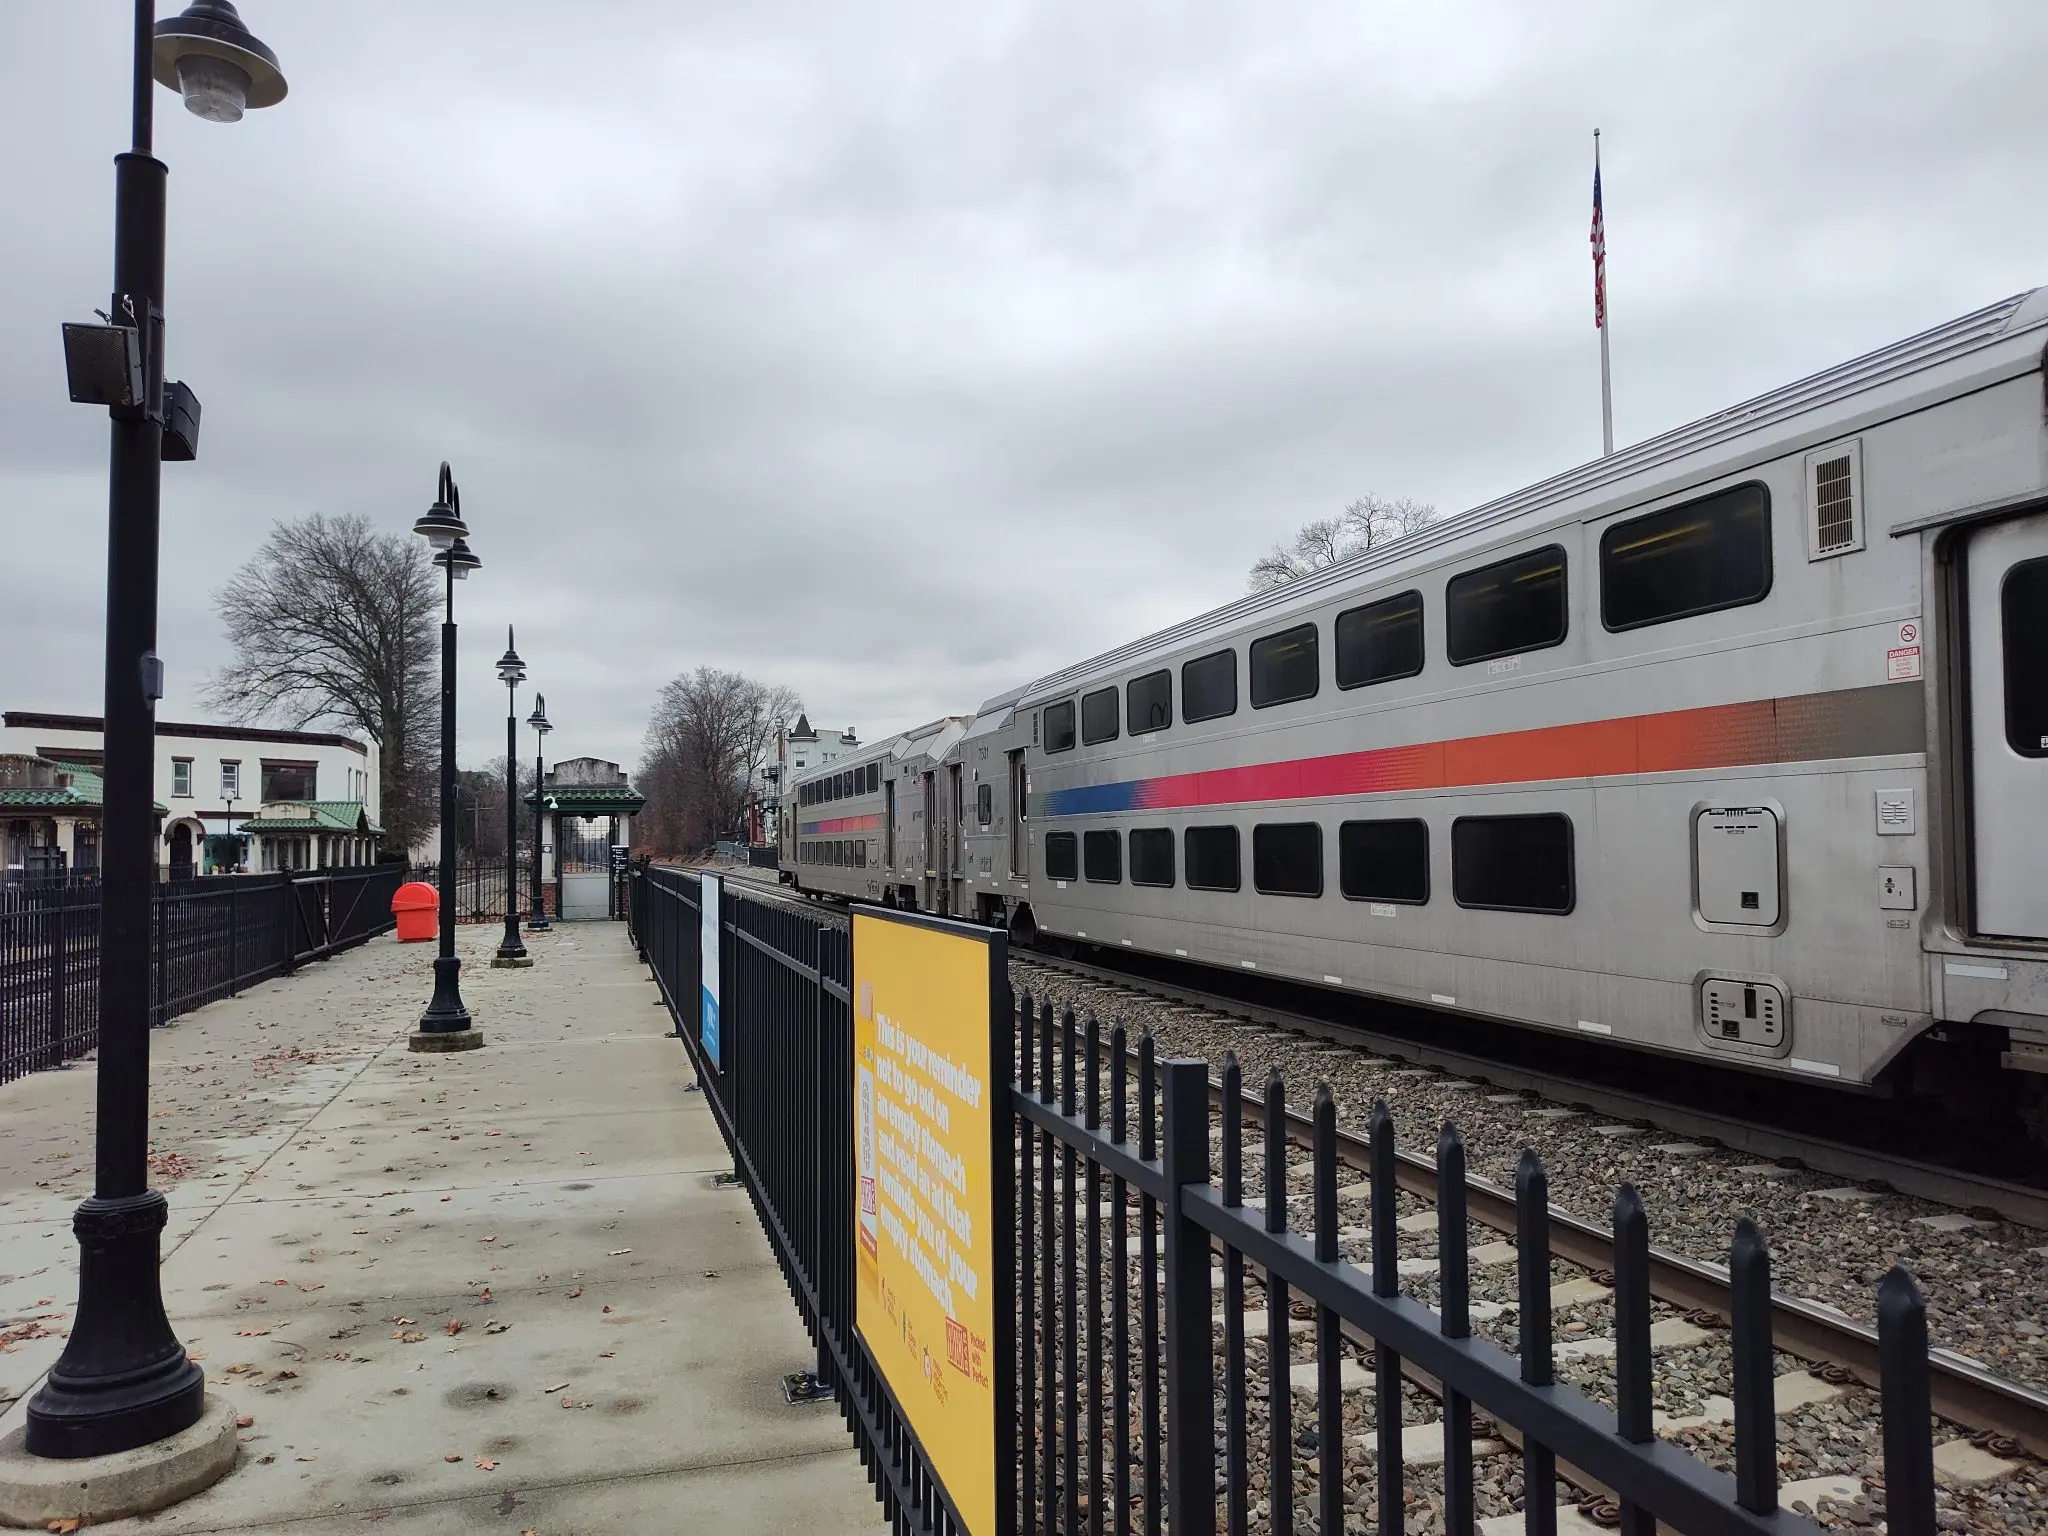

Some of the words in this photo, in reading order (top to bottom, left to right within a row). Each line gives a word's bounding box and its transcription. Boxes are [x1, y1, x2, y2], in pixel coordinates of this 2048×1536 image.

[1889, 648, 1918, 657] DANGER
[877, 1012, 894, 1050] This
[896, 1022, 904, 1056] is
[906, 1034, 927, 1072] your
[928, 1048, 980, 1109] reminder
[877, 1055, 891, 1087] not
[892, 1060, 903, 1094] to
[905, 1074, 917, 1106] go
[919, 1084, 934, 1121] out
[936, 1098, 948, 1135] on
[878, 1092, 888, 1121] an
[889, 1101, 920, 1155] empty
[922, 1126, 966, 1197] stomach
[879, 1128, 895, 1164] and
[896, 1144, 918, 1187] read
[919, 1168, 931, 1203] an
[932, 1182, 944, 1219] ad
[945, 1191, 972, 1248] that
[880, 1202, 909, 1260] empty
[880, 1165, 915, 1224] reminds
[917, 1205, 934, 1250] you
[936, 1229, 947, 1265] of
[949, 1244, 977, 1301] your
[970, 1331, 987, 1353] Packed
[971, 1350, 982, 1367] with
[972, 1366, 989, 1389] Perfect
